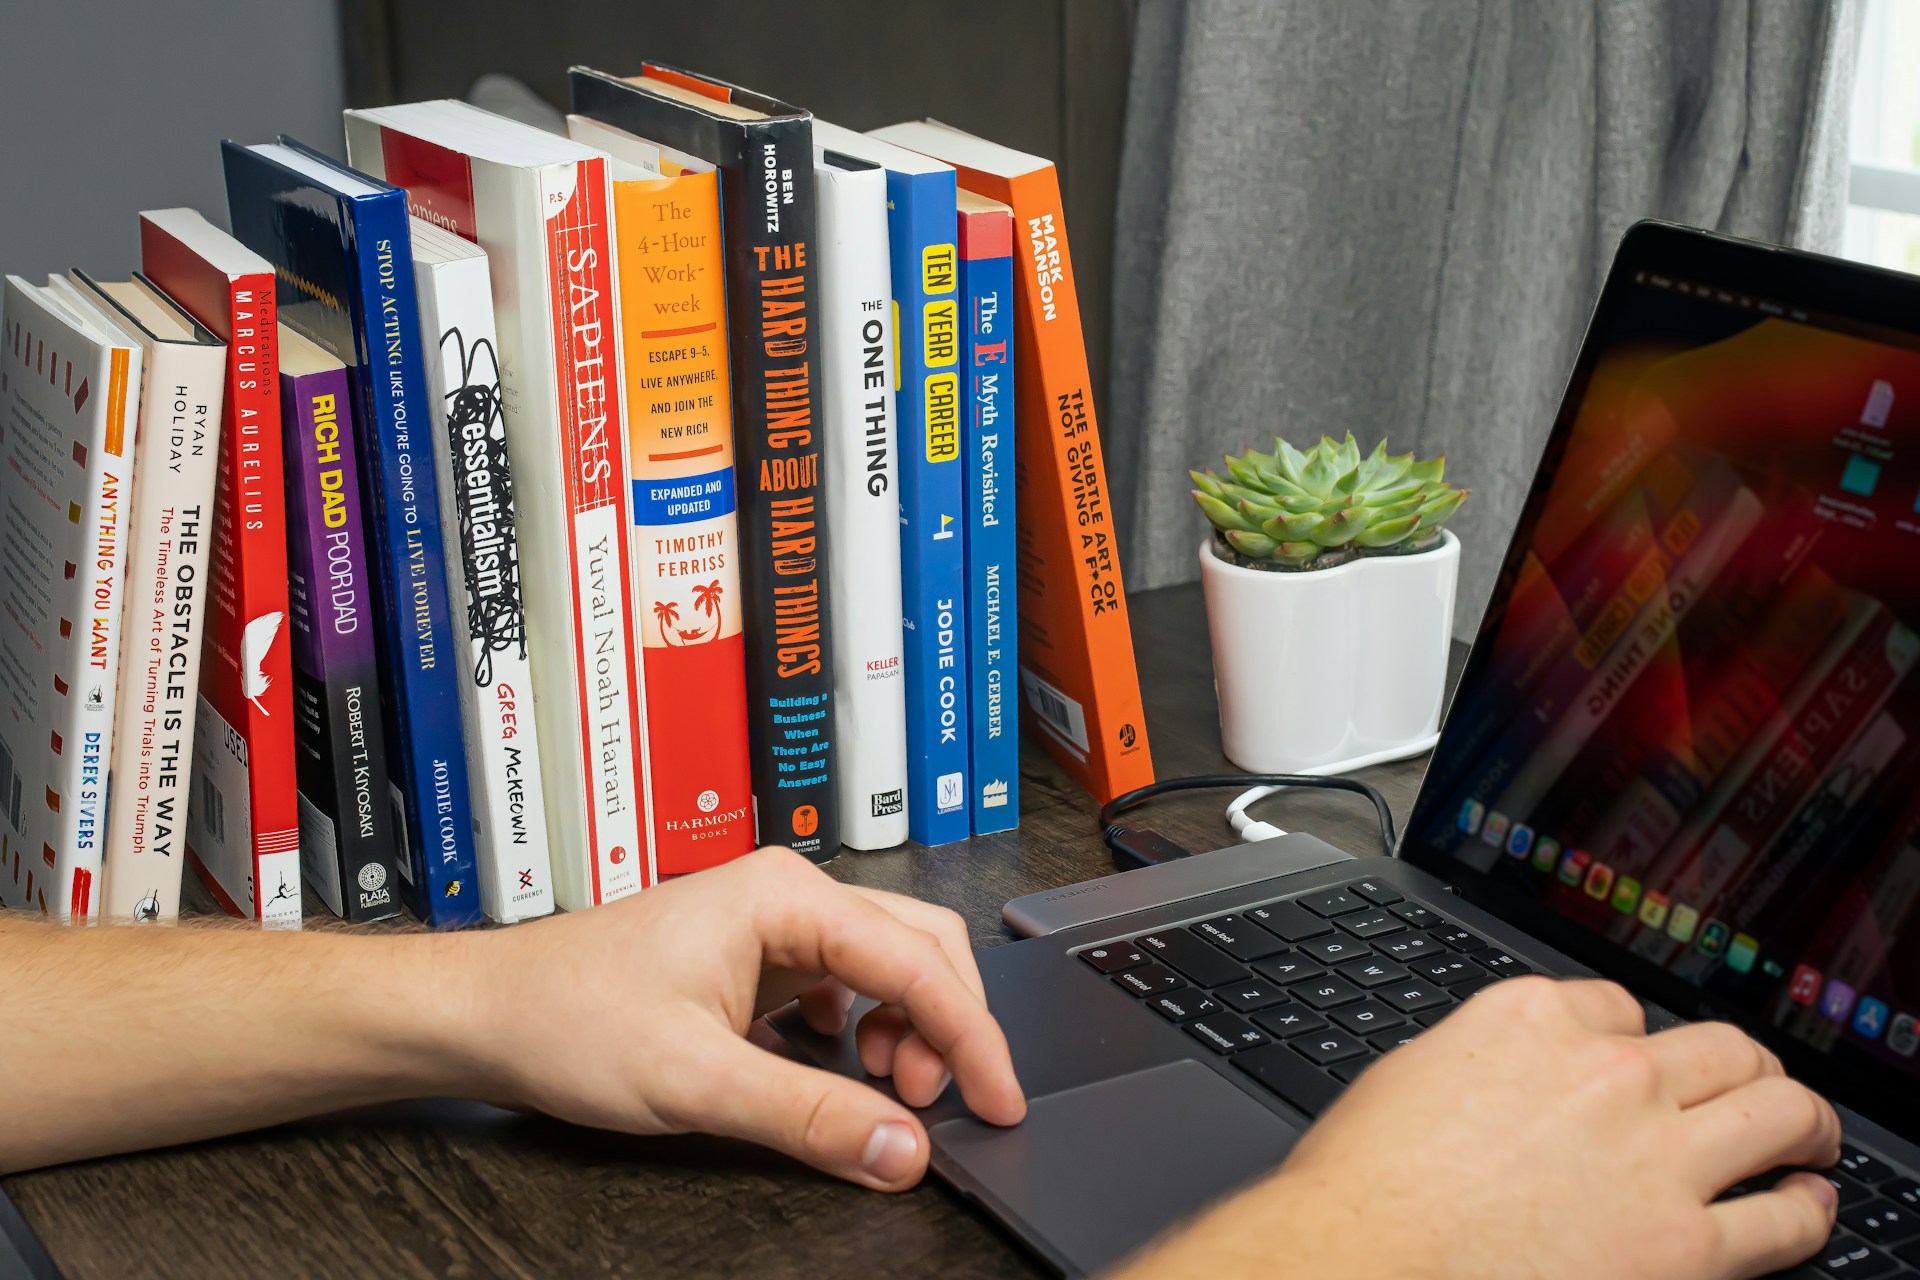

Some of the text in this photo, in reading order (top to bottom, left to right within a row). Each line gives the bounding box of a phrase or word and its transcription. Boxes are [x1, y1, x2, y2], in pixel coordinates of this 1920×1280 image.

[764, 144, 779, 233] HOROWITZ
[782, 169, 793, 204] BEN
[549, 192, 566, 204] P.S.
[653, 202, 691, 222] The
[638, 233, 706, 254] 4-Hour
[1042, 214, 1064, 284] MARK
[643, 266, 704, 284] Work-
[1028, 218, 1057, 321] MANSON
[654, 294, 700, 315] week
[862, 300, 883, 312] THE
[259, 290, 273, 396] Meditations
[649, 348, 688, 363] ESCAPE
[927, 250, 955, 458] TEN YEAR CAREER
[567, 248, 611, 483] SAPIENS
[641, 369, 718, 389] LIVE ANYWHERE,
[236, 291, 263, 530] MARCUS AURELIUS
[651, 396, 713, 414] AND JOIN THE
[862, 319, 888, 496] ONE THING
[974, 292, 1006, 528] The E Myth Revisited
[168, 386, 188, 474] HOLIDAY
[192, 405, 207, 456] RYAN
[661, 422, 709, 439] NEW RICH
[376, 239, 435, 671] STOP ACTING LIKE YOU'RE GOING TO LIVE FOREVER
[753, 242, 821, 678] THE HARD THING ABOUT HARD THINGS
[1058, 394, 1076, 438] NOT
[1067, 447, 1090, 527] GIVING
[1081, 534, 1094, 549] A
[651, 480, 722, 501] EXPANDED AND
[1071, 388, 1119, 611] THE SUBTLE ART OF
[312, 393, 358, 635] RICH DAD POOR DAD
[462, 422, 505, 598] essentialism
[667, 500, 711, 516] UPDATED
[655, 530, 724, 555] TIMOTHY
[90, 471, 120, 670] ANYTHING YOU WANT
[658, 554, 725, 578] FERRISS
[986, 565, 1001, 740] MICHAEL E. GERBER
[866, 656, 899, 671] KELLER
[937, 599, 956, 744] JODIE COOK
[132, 507, 174, 854] The Timeless Art of Turning Trials into Triumph
[153, 504, 201, 857] THE OBSTACLE IS THE WAY
[589, 534, 626, 819] Yuval Noah Harari
[867, 669, 899, 681] PAPASAN
[770, 693, 828, 708] Building a
[497, 683, 517, 740] GREG
[774, 710, 826, 724] Business
[784, 728, 819, 740] When
[772, 740, 829, 756] There Are
[82, 732, 100, 785] DEREK
[346, 687, 374, 838] ROBERT T. KIYOSAKI
[778, 758, 826, 772] No Easy
[778, 774, 828, 788] Answers
[874, 789, 901, 806] Bard
[433, 759, 458, 864] JODIE COOK
[666, 807, 747, 831] HARMONY
[873, 802, 902, 816] Press
[78, 791, 97, 849] SIVERS
[692, 828, 728, 841] BOOKS
[792, 838, 820, 848] HARPER
[360, 889, 389, 902] PLATA
[512, 890, 543, 902] CURRENCY
[1362, 882, 1378, 892] esc
[1255, 909, 1270, 919] tab
[1146, 936, 1166, 949] shift
[1201, 923, 1235, 944] caps lock
[1327, 944, 1343, 953] Q
[1392, 944, 1408, 952] 2
[1279, 964, 1296, 972] A
[1364, 966, 1383, 976] W
[1124, 974, 1152, 991] control
[1318, 988, 1335, 996] S
[1242, 990, 1260, 999] Z
[1404, 991, 1422, 999] E
[1161, 999, 1186, 1016] option
[1356, 1012, 1374, 1021] D
[1280, 1015, 1299, 1024] X
[1195, 1022, 1234, 1048] command
[1320, 1041, 1338, 1050] C
